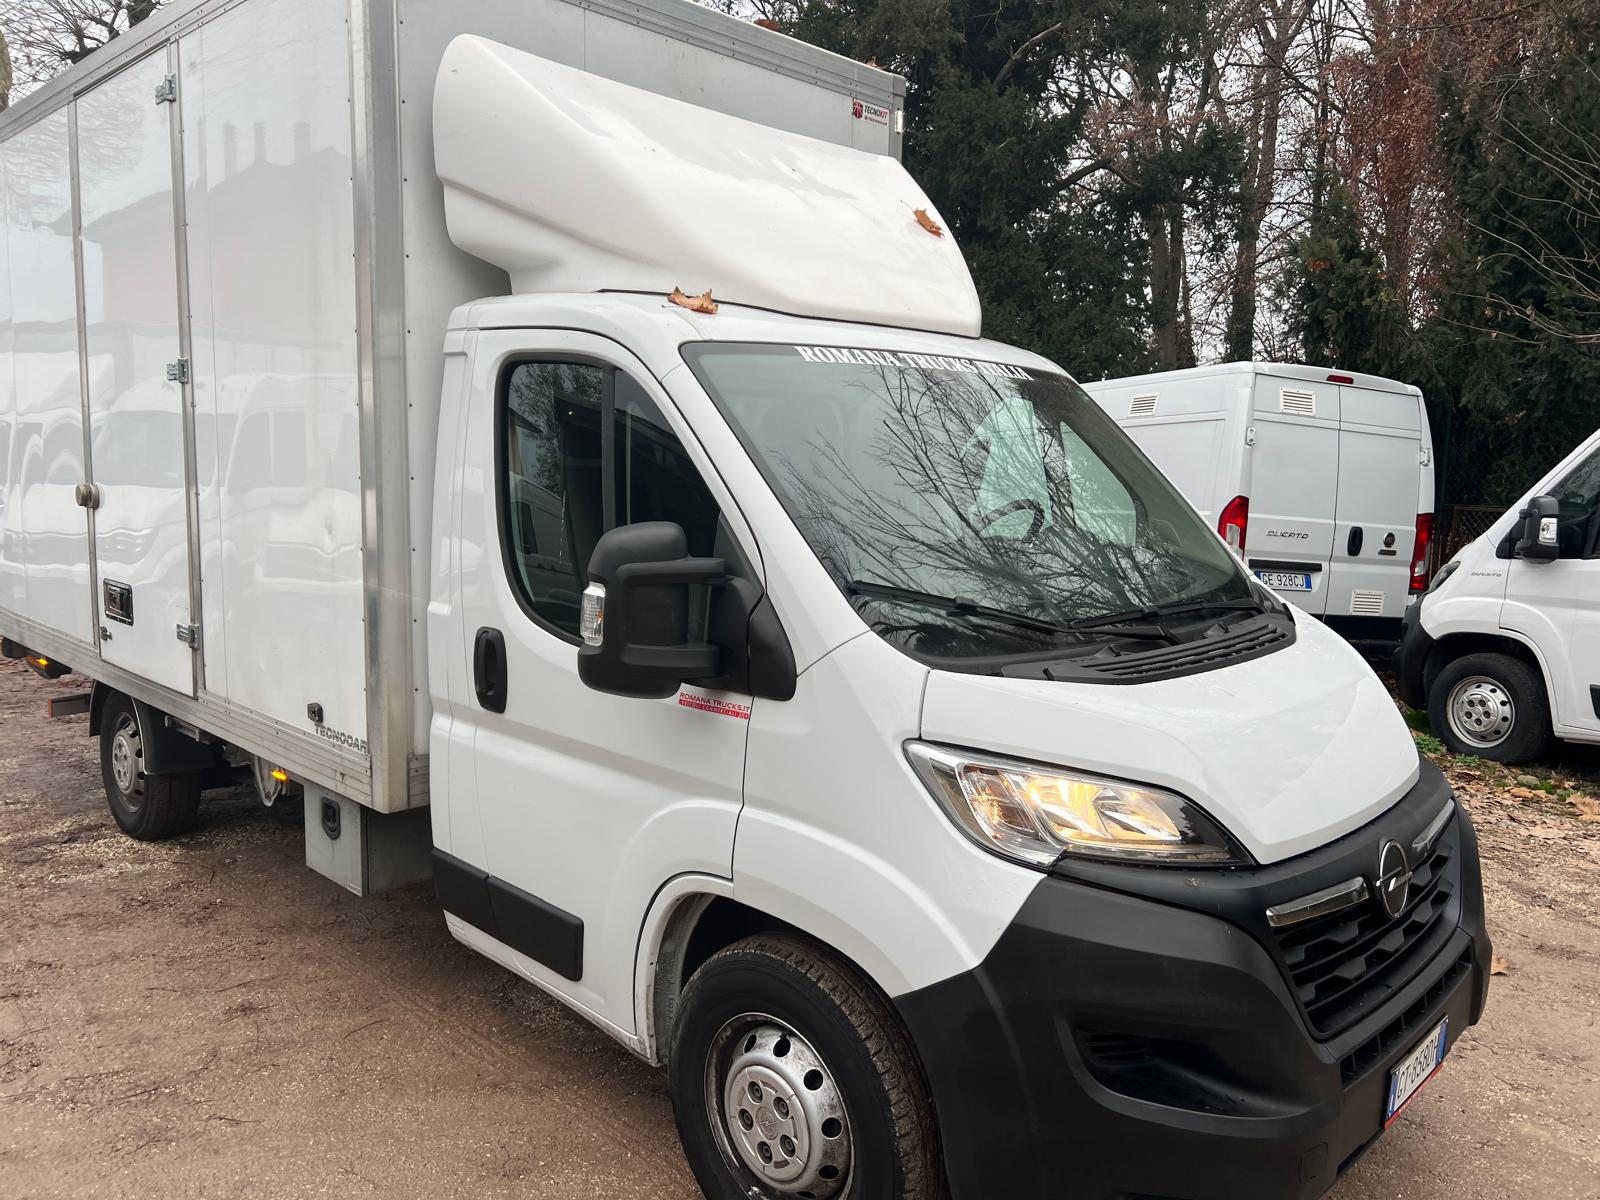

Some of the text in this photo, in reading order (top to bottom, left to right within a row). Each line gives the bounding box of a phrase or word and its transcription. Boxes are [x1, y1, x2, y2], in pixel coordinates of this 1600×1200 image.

[794, 346, 1034, 380] ROMANA TRUCKS ITALIA
[1262, 573, 1304, 587] GE 928CJ
[680, 692, 750, 712] ROMANA TRUCKS.IT
[314, 722, 367, 753] TECNOCAR
